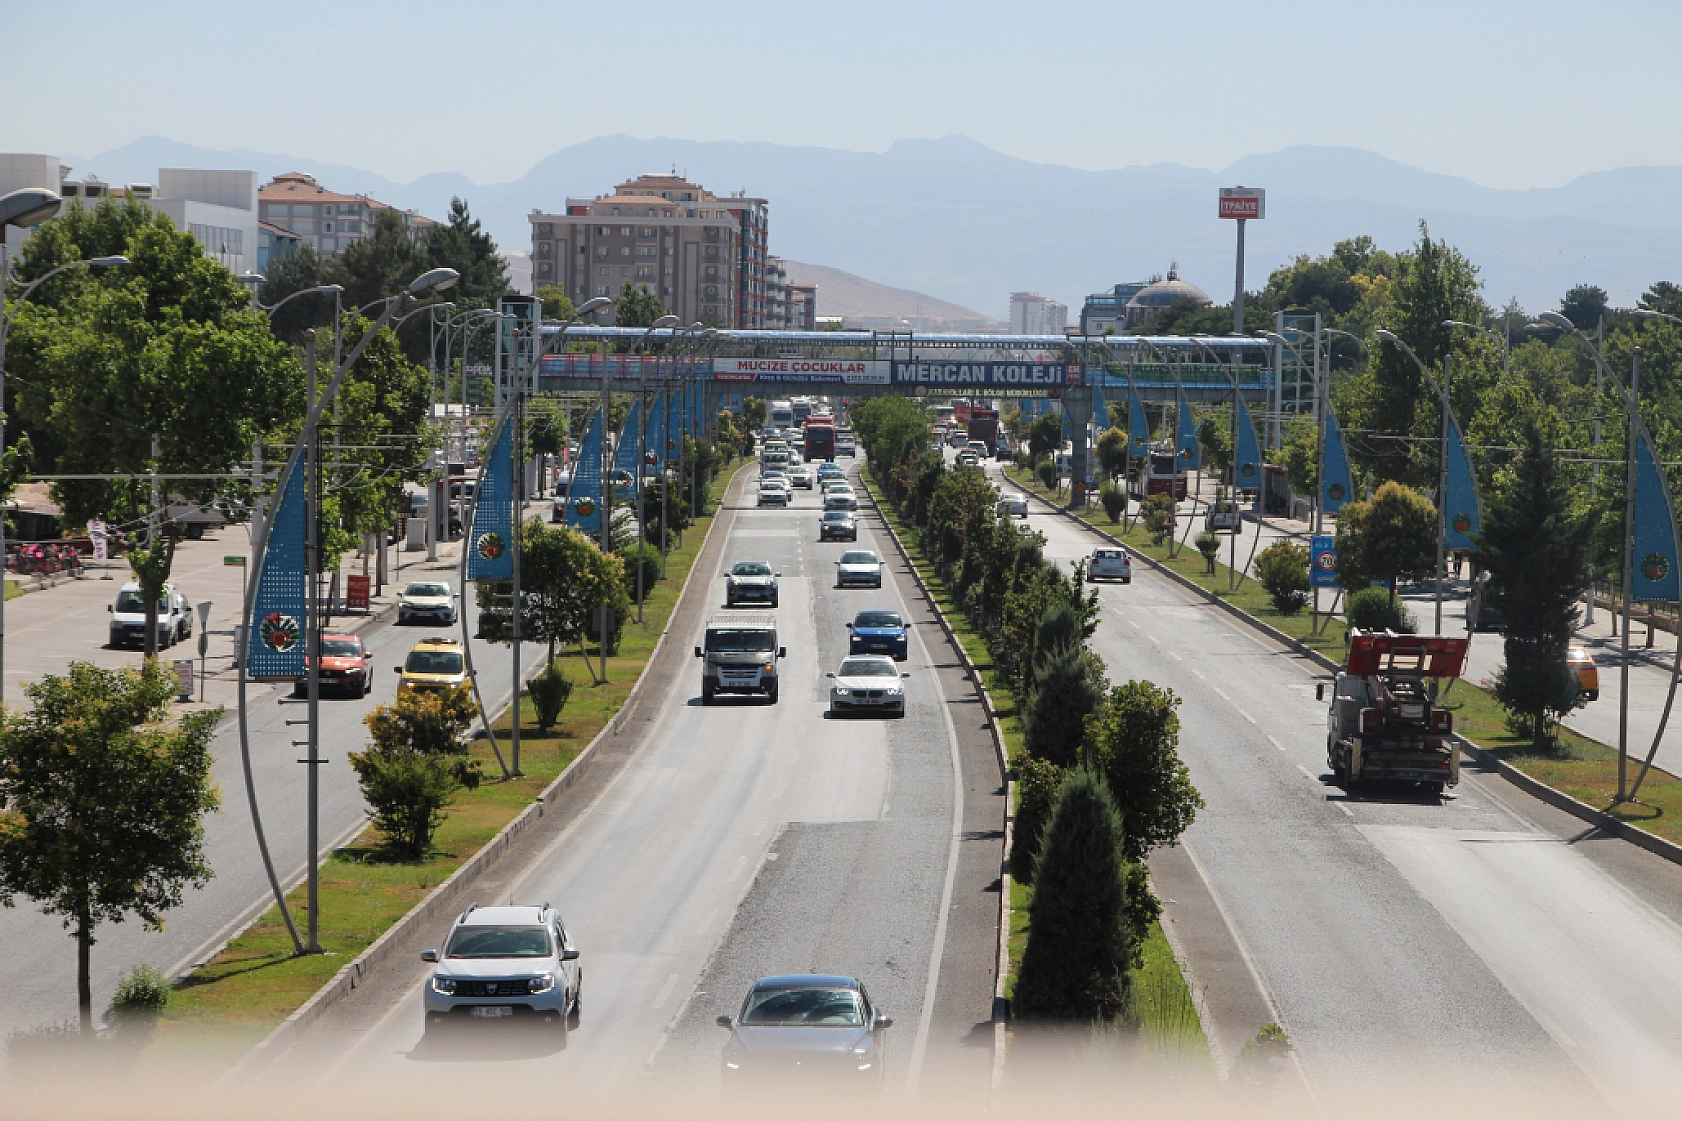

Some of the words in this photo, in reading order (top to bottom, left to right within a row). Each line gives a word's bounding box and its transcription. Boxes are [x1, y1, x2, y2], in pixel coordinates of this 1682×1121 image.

[792, 362, 865, 374] ÇOCUKLAR
[897, 364, 985, 382] MERCAN
[1322, 556, 1333, 566] 70
